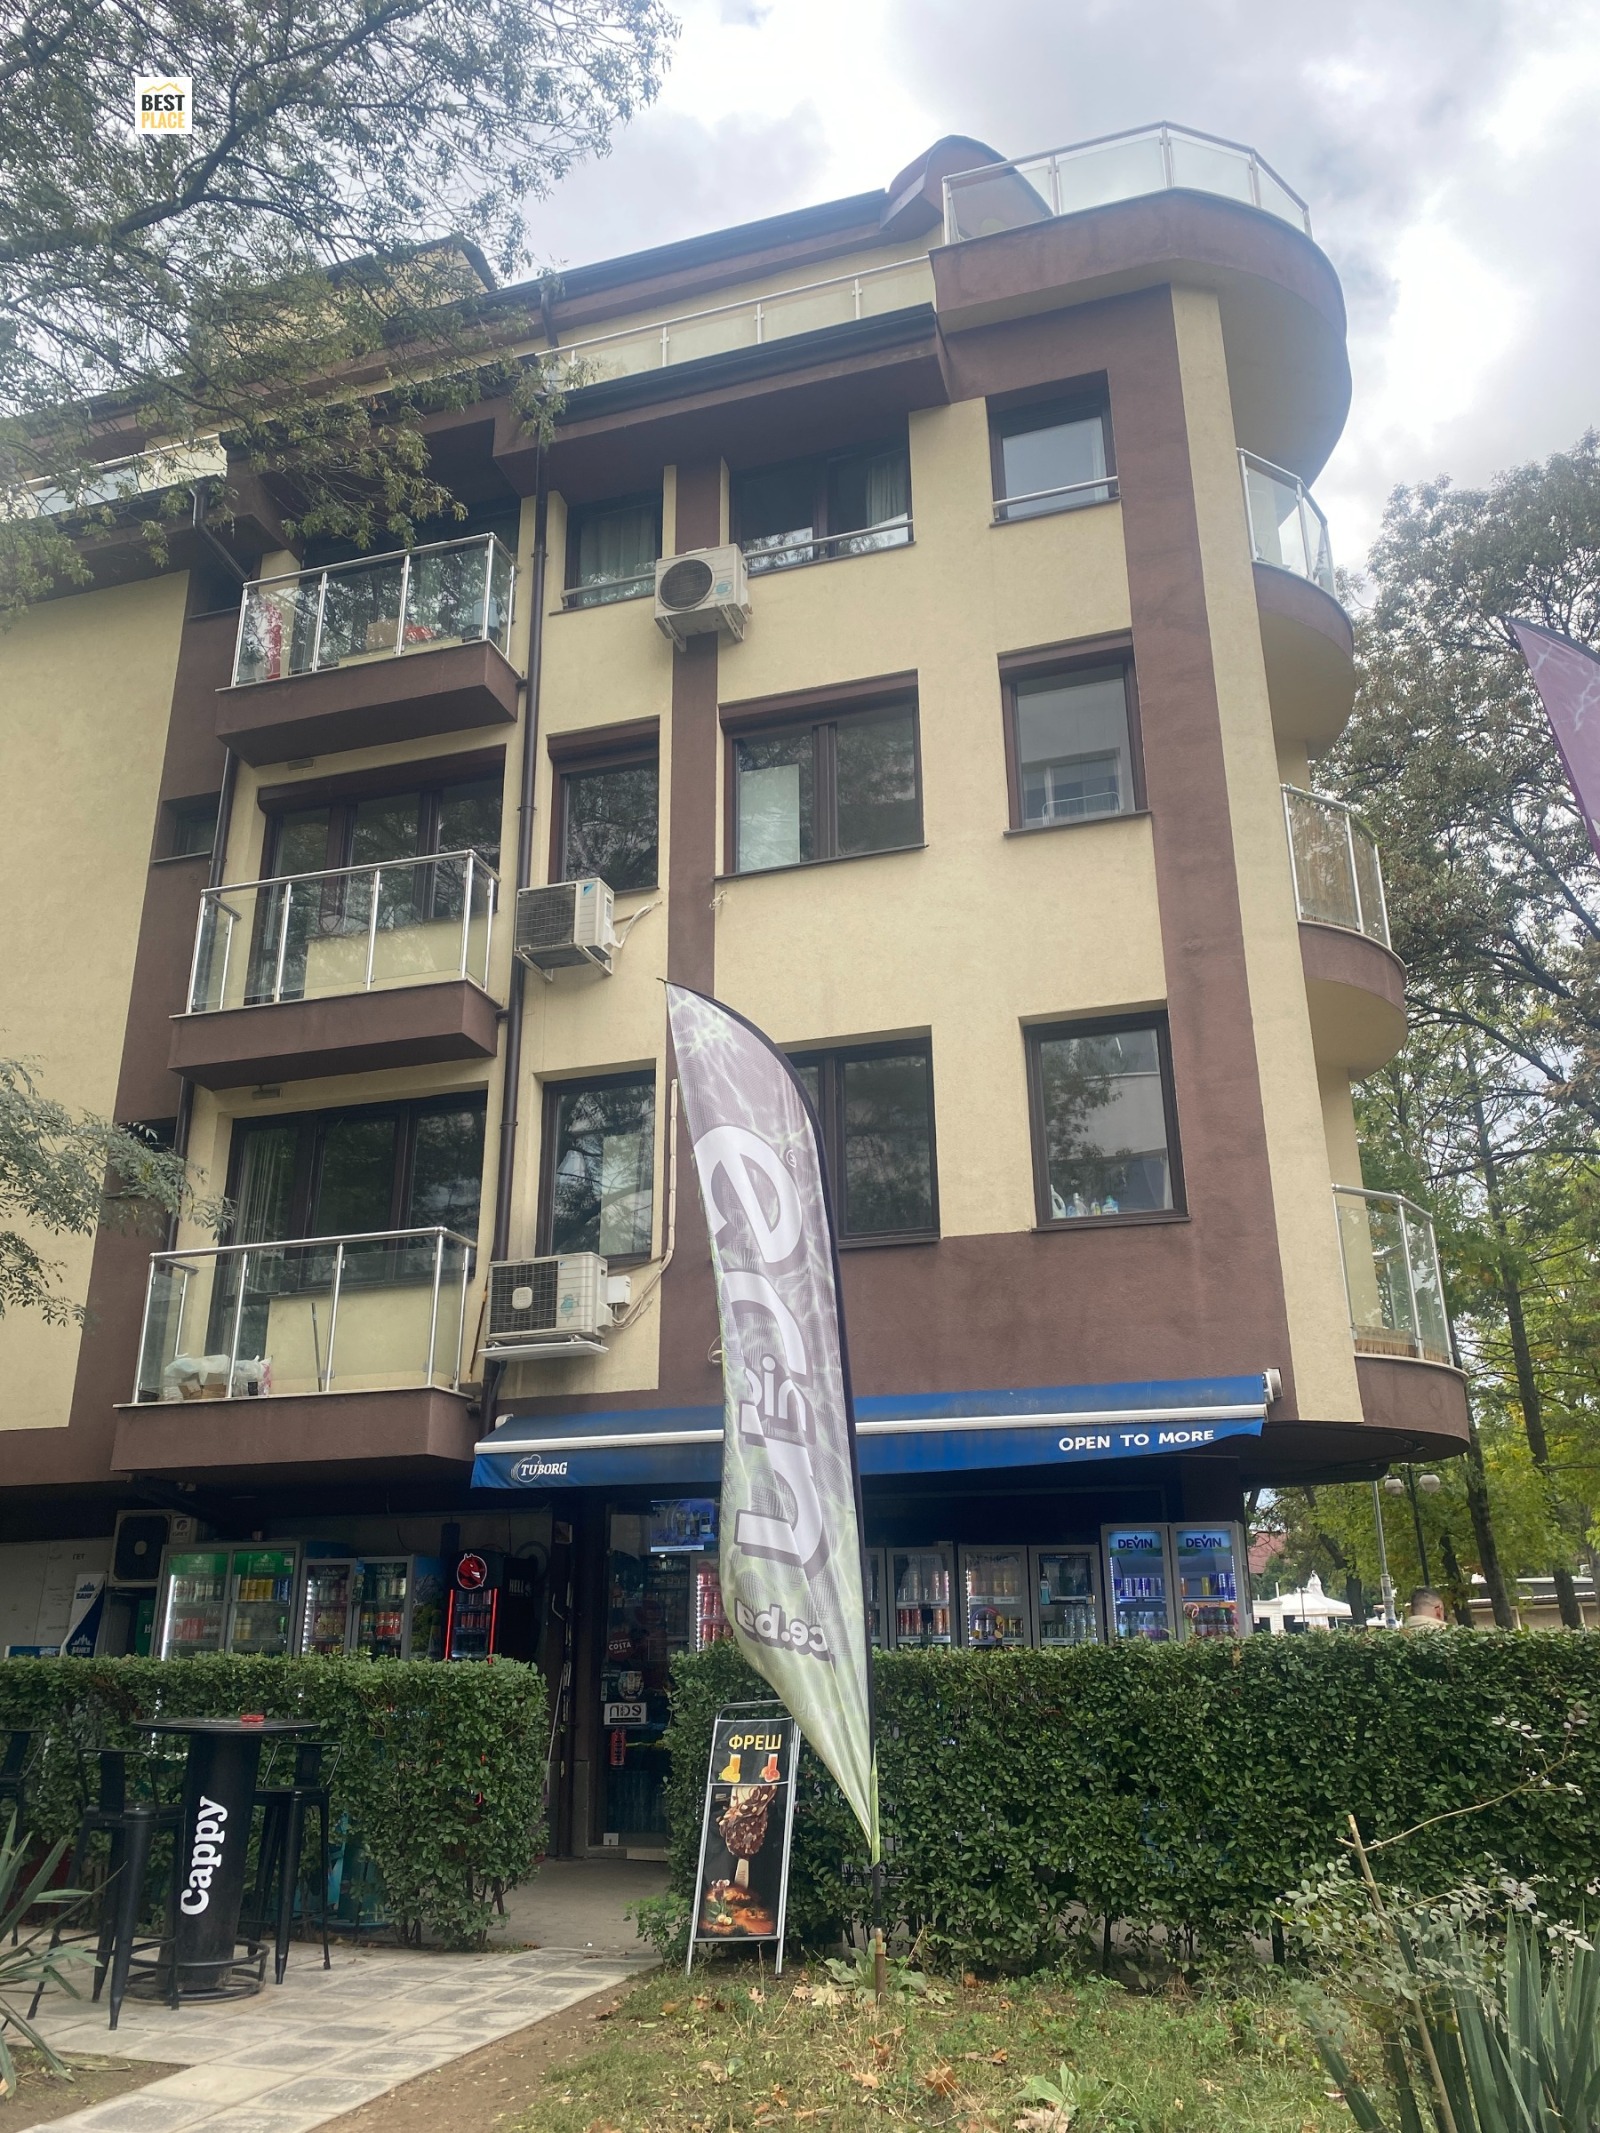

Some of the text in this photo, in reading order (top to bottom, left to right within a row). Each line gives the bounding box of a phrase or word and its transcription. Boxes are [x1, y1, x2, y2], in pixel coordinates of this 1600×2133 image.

[1058, 1430, 1214, 1451] OPEN TO MORE
[521, 1461, 568, 1476] TUBORG
[1118, 1538, 1153, 1549] DEVIN
[1186, 1537, 1222, 1548] DEVIN
[608, 1641, 632, 1651] COSTA
[729, 1734, 782, 1750] ФРЕШ
[180, 1795, 228, 1915] Cappy
